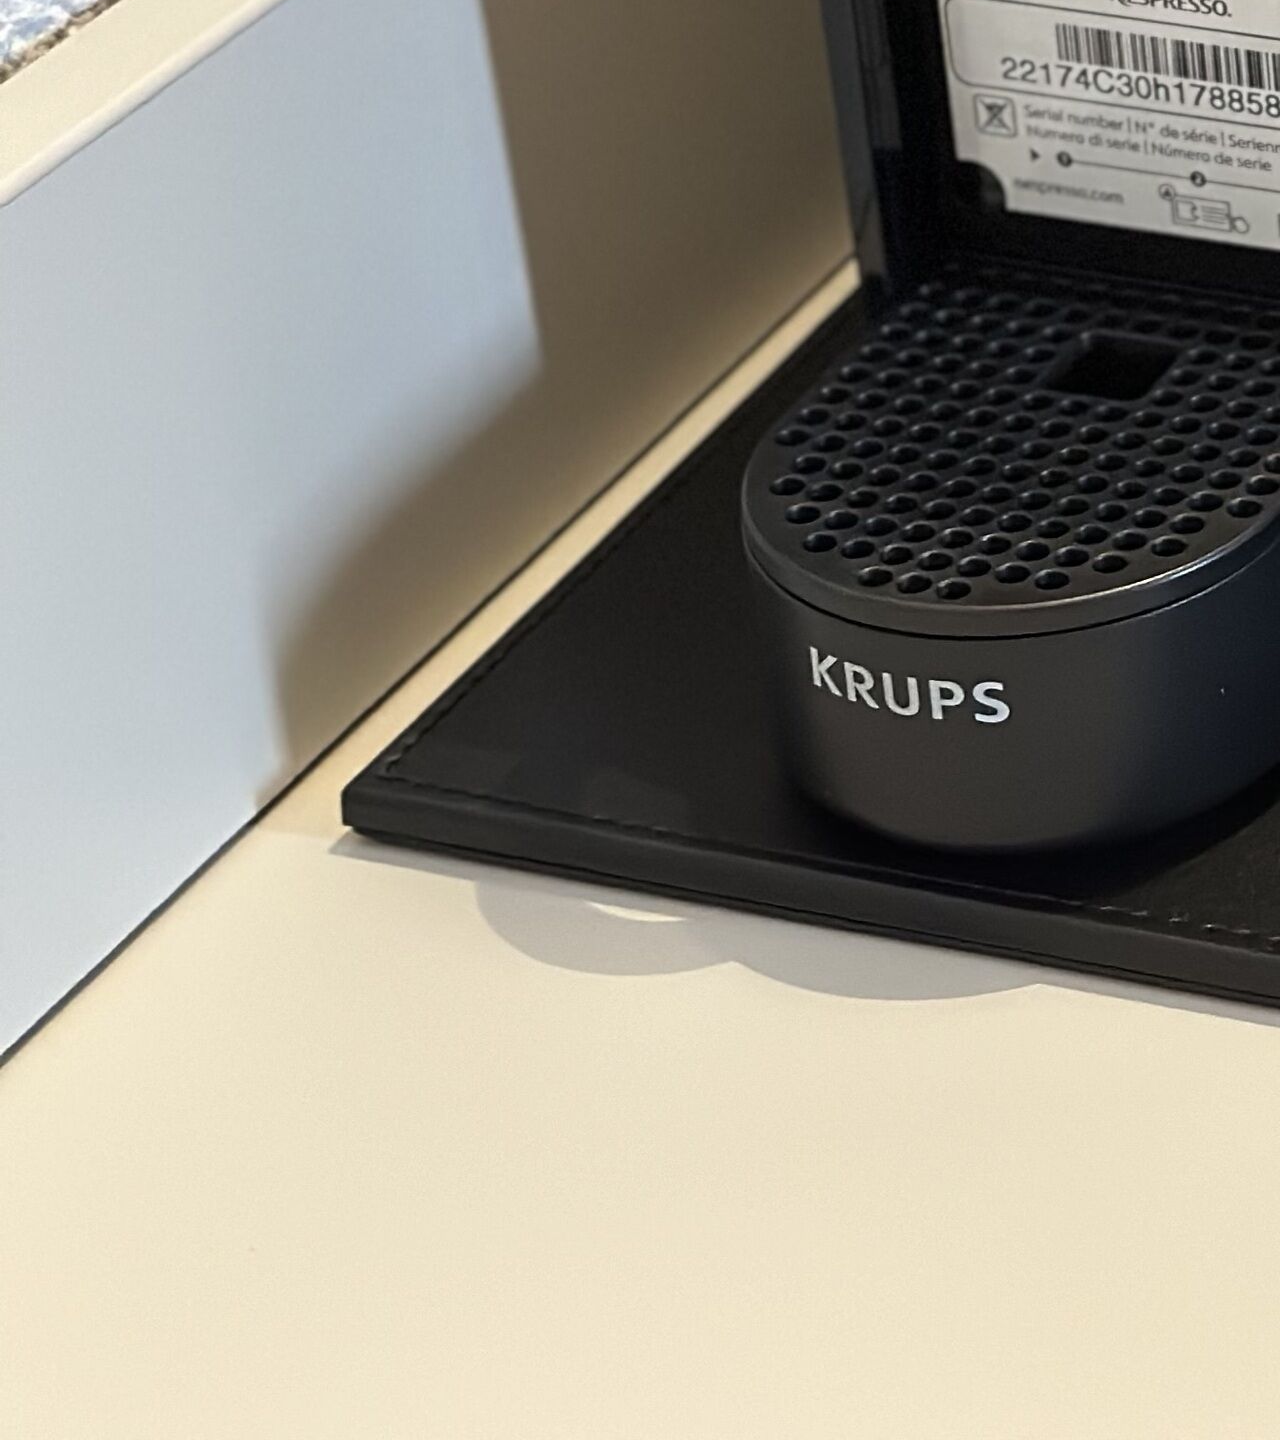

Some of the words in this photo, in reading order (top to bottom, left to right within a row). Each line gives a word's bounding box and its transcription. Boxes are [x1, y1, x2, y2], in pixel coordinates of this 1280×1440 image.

[1024, 104, 1063, 122] Serial
[1067, 112, 1123, 131] number
[1160, 123, 1180, 140] de
[1182, 127, 1218, 145] série
[1106, 138, 1141, 153] serie
[1152, 141, 1211, 163] Número
[1214, 150, 1234, 167] de
[1236, 157, 1273, 172] serie
[809, 645, 1011, 724] KRUPS
